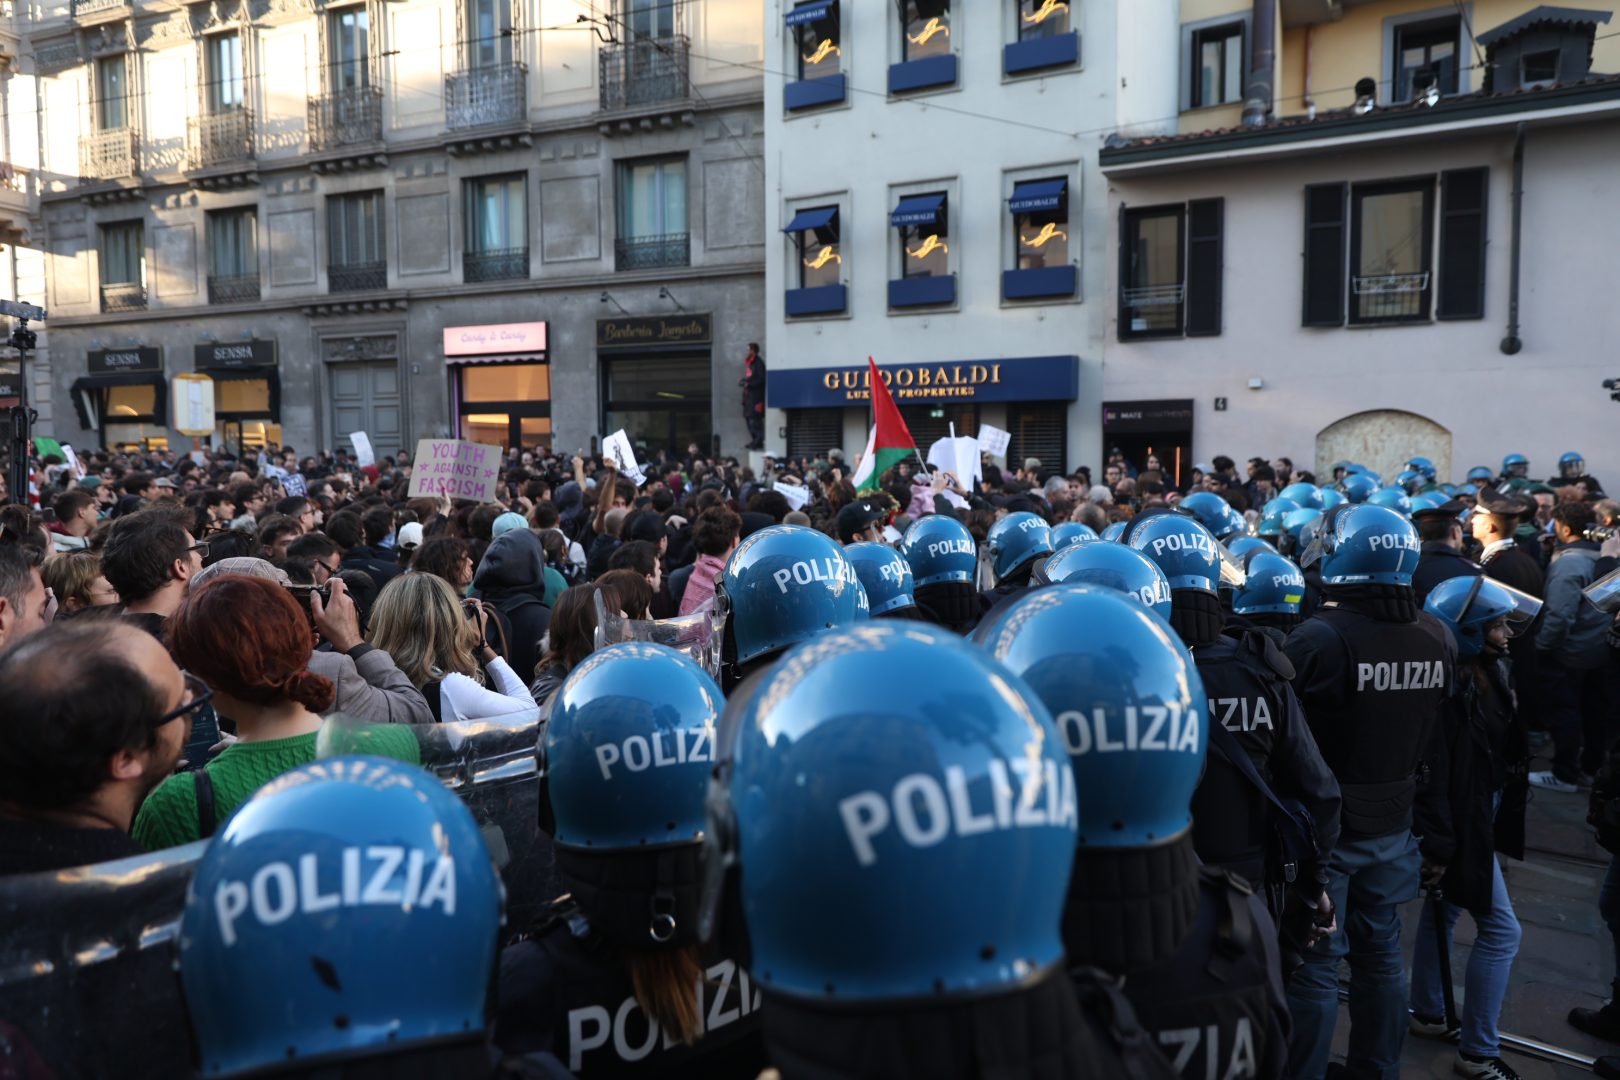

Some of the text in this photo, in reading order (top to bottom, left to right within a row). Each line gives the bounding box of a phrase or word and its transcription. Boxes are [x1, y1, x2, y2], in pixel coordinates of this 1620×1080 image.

[898, 386, 976, 399] PROPERTIES
[432, 442, 486, 463] YOUTH
[433, 462, 479, 477] AGAINST
[418, 477, 486, 498] FASCISM
[773, 556, 858, 594] POLIZIA
[1357, 660, 1445, 692] POLIZIA
[1055, 705, 1199, 756] OLIZIA
[594, 726, 717, 781] POLIZI
[838, 758, 1078, 867] POLIZIA
[214, 845, 457, 947] POLIZIA
